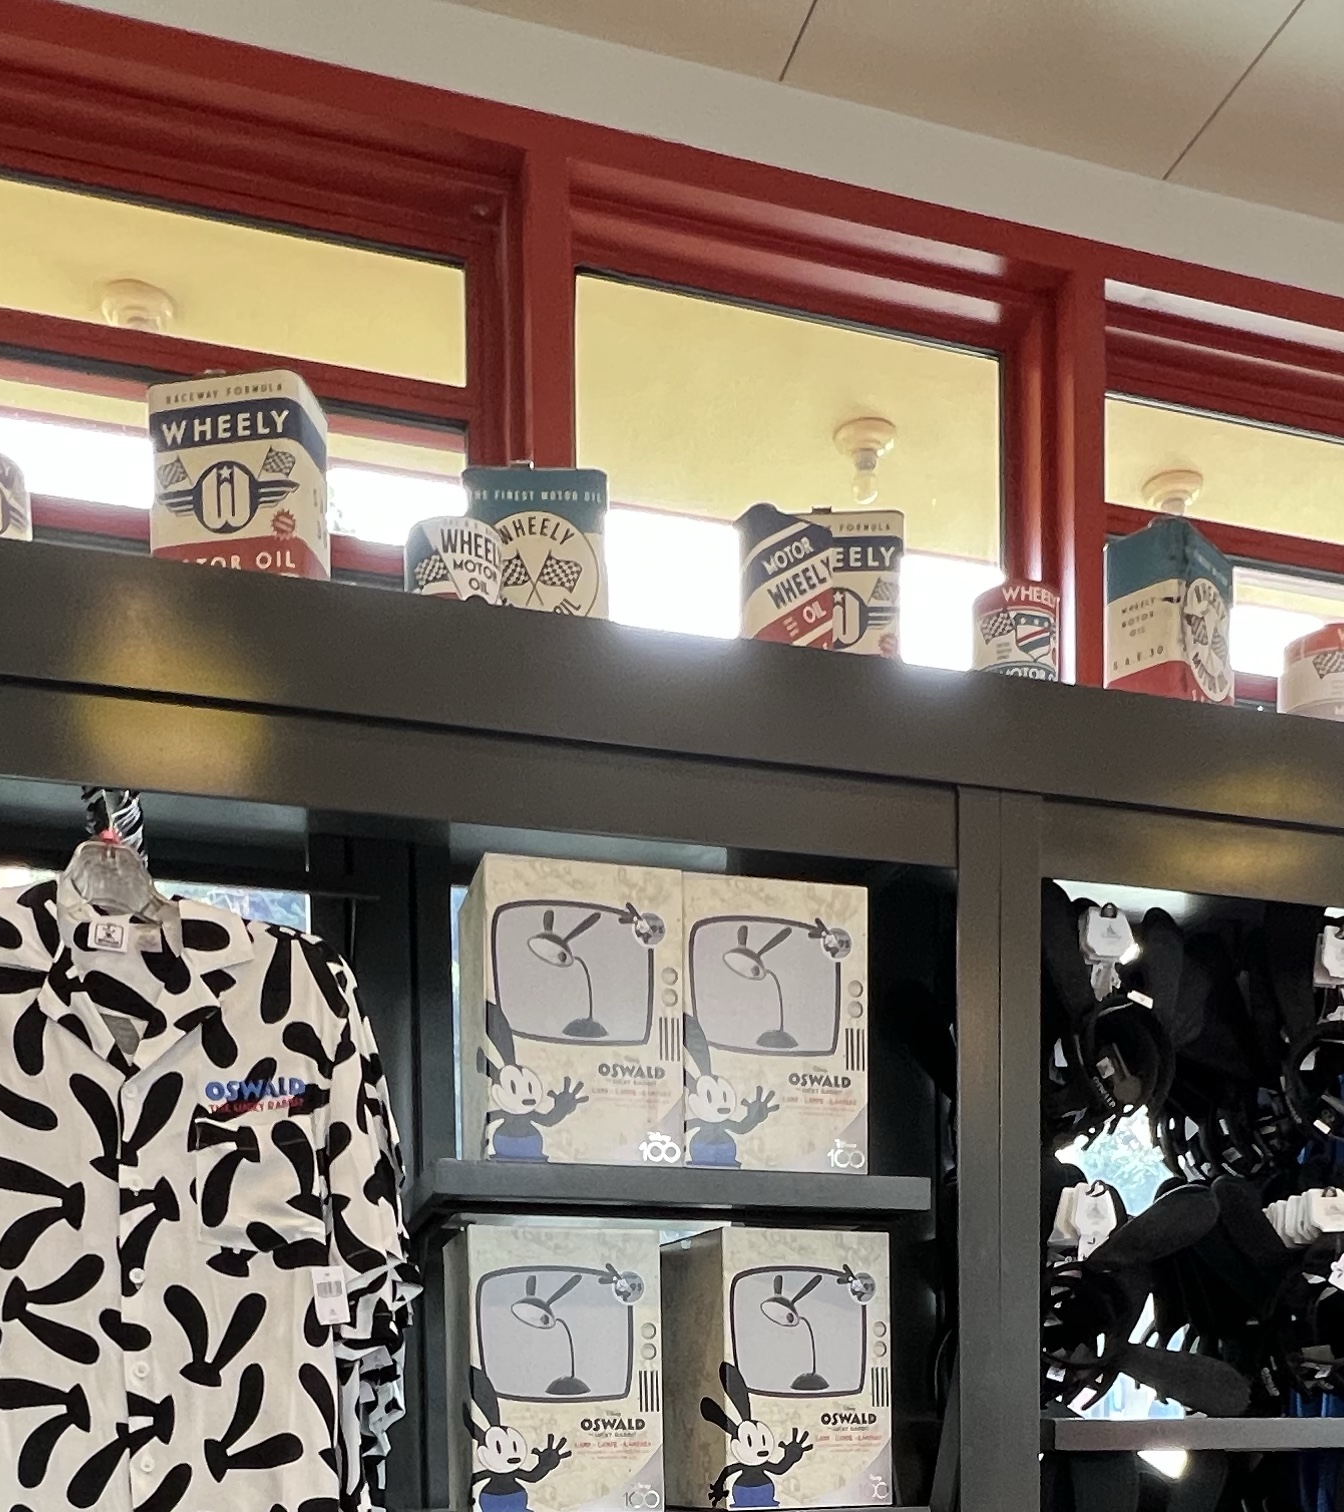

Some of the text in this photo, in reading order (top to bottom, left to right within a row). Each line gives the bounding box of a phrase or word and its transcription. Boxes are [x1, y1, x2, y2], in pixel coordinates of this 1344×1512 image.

[164, 382, 284, 406] RACEWAY FORMULA
[161, 408, 291, 447] WHEELY
[494, 490, 536, 502] FINEST
[541, 490, 579, 502] MOTOR
[584, 490, 602, 504] OIL
[499, 516, 575, 545] WHEELY
[839, 522, 891, 533] FORMULA
[256, 550, 296, 570] OIL
[761, 536, 814, 576] MOTOR
[468, 577, 490, 596] OIL
[766, 556, 833, 610] WHEELY
[803, 601, 827, 624] OIL
[598, 1063, 666, 1080] OSWALD
[788, 1072, 852, 1089] OSWALD
[204, 1076, 306, 1102] OSWALD
[638, 1141, 681, 1164] 100
[826, 1148, 865, 1169] 100
[580, 1418, 646, 1432] OSWALD
[820, 1412, 878, 1426] OSWALD
